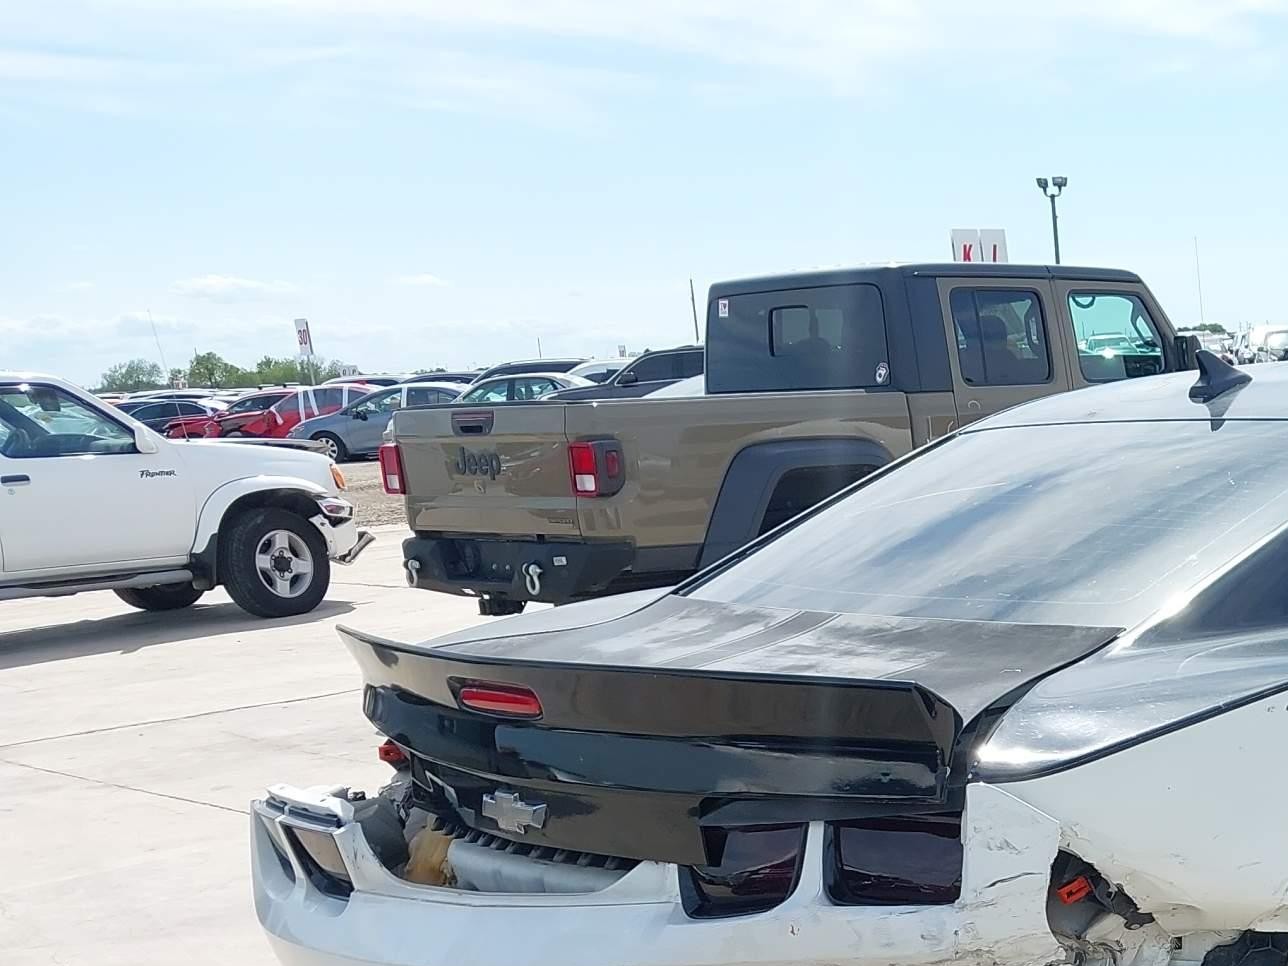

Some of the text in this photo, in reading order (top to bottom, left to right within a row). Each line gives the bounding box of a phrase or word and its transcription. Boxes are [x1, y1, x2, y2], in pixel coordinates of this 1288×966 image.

[963, 244, 972, 262] K
[298, 329, 308, 345] 30
[456, 446, 501, 480] Jeep
